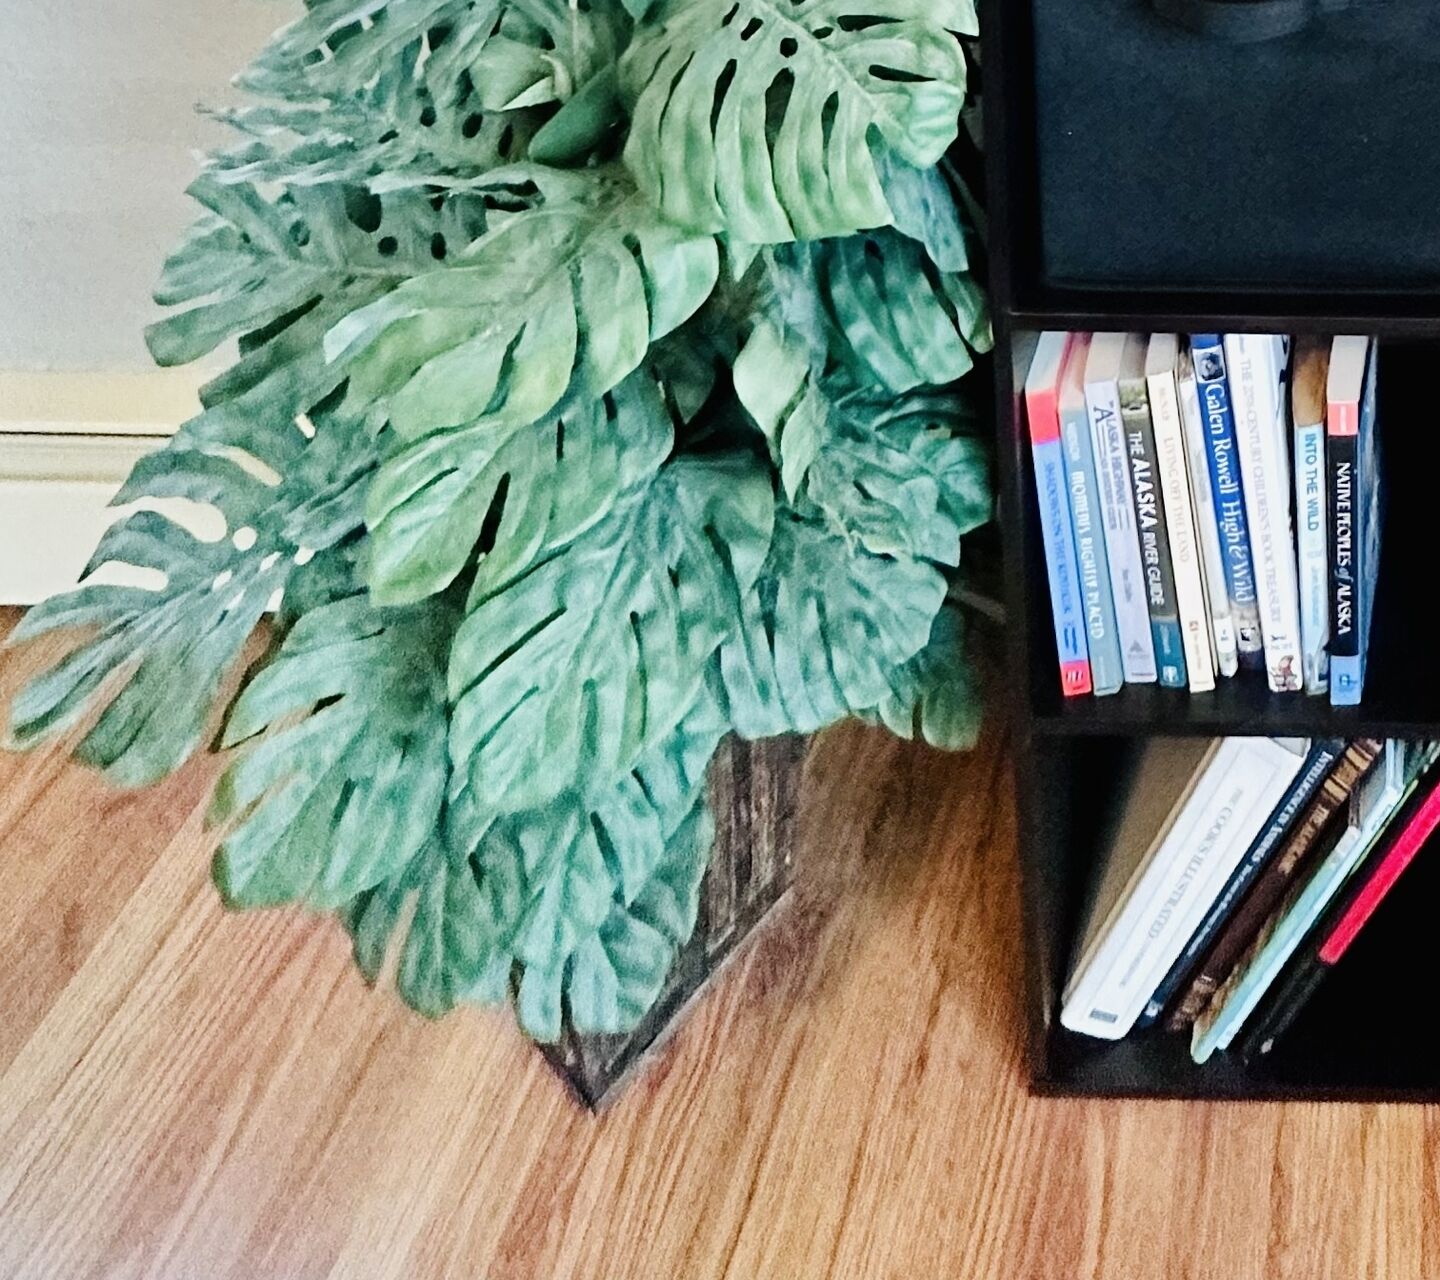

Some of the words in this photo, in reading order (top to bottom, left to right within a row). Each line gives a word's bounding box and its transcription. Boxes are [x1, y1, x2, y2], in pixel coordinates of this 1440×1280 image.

[1093, 404, 1120, 454] ALASKA
[1205, 383, 1230, 435] Galen
[1129, 431, 1144, 456] THE
[1164, 437, 1179, 478] LIVING
[1305, 433, 1317, 465] INTO
[1212, 437, 1239, 495] Rowell
[1305, 468, 1318, 494] THE
[1337, 461, 1351, 511] NATIVE
[1070, 471, 1091, 533] MOMENTS
[1132, 457, 1158, 528] ALASKA
[1173, 504, 1185, 527] THE
[1217, 499, 1248, 544] High
[1307, 498, 1319, 532] WILD
[1142, 531, 1159, 565] RIVER
[1177, 531, 1190, 562] LAND
[1228, 544, 1247, 561] &
[1336, 511, 1351, 567] PEOPLES
[1147, 565, 1165, 607] GUIDE
[1231, 562, 1255, 603] Wild
[1338, 581, 1352, 635] ALASKA
